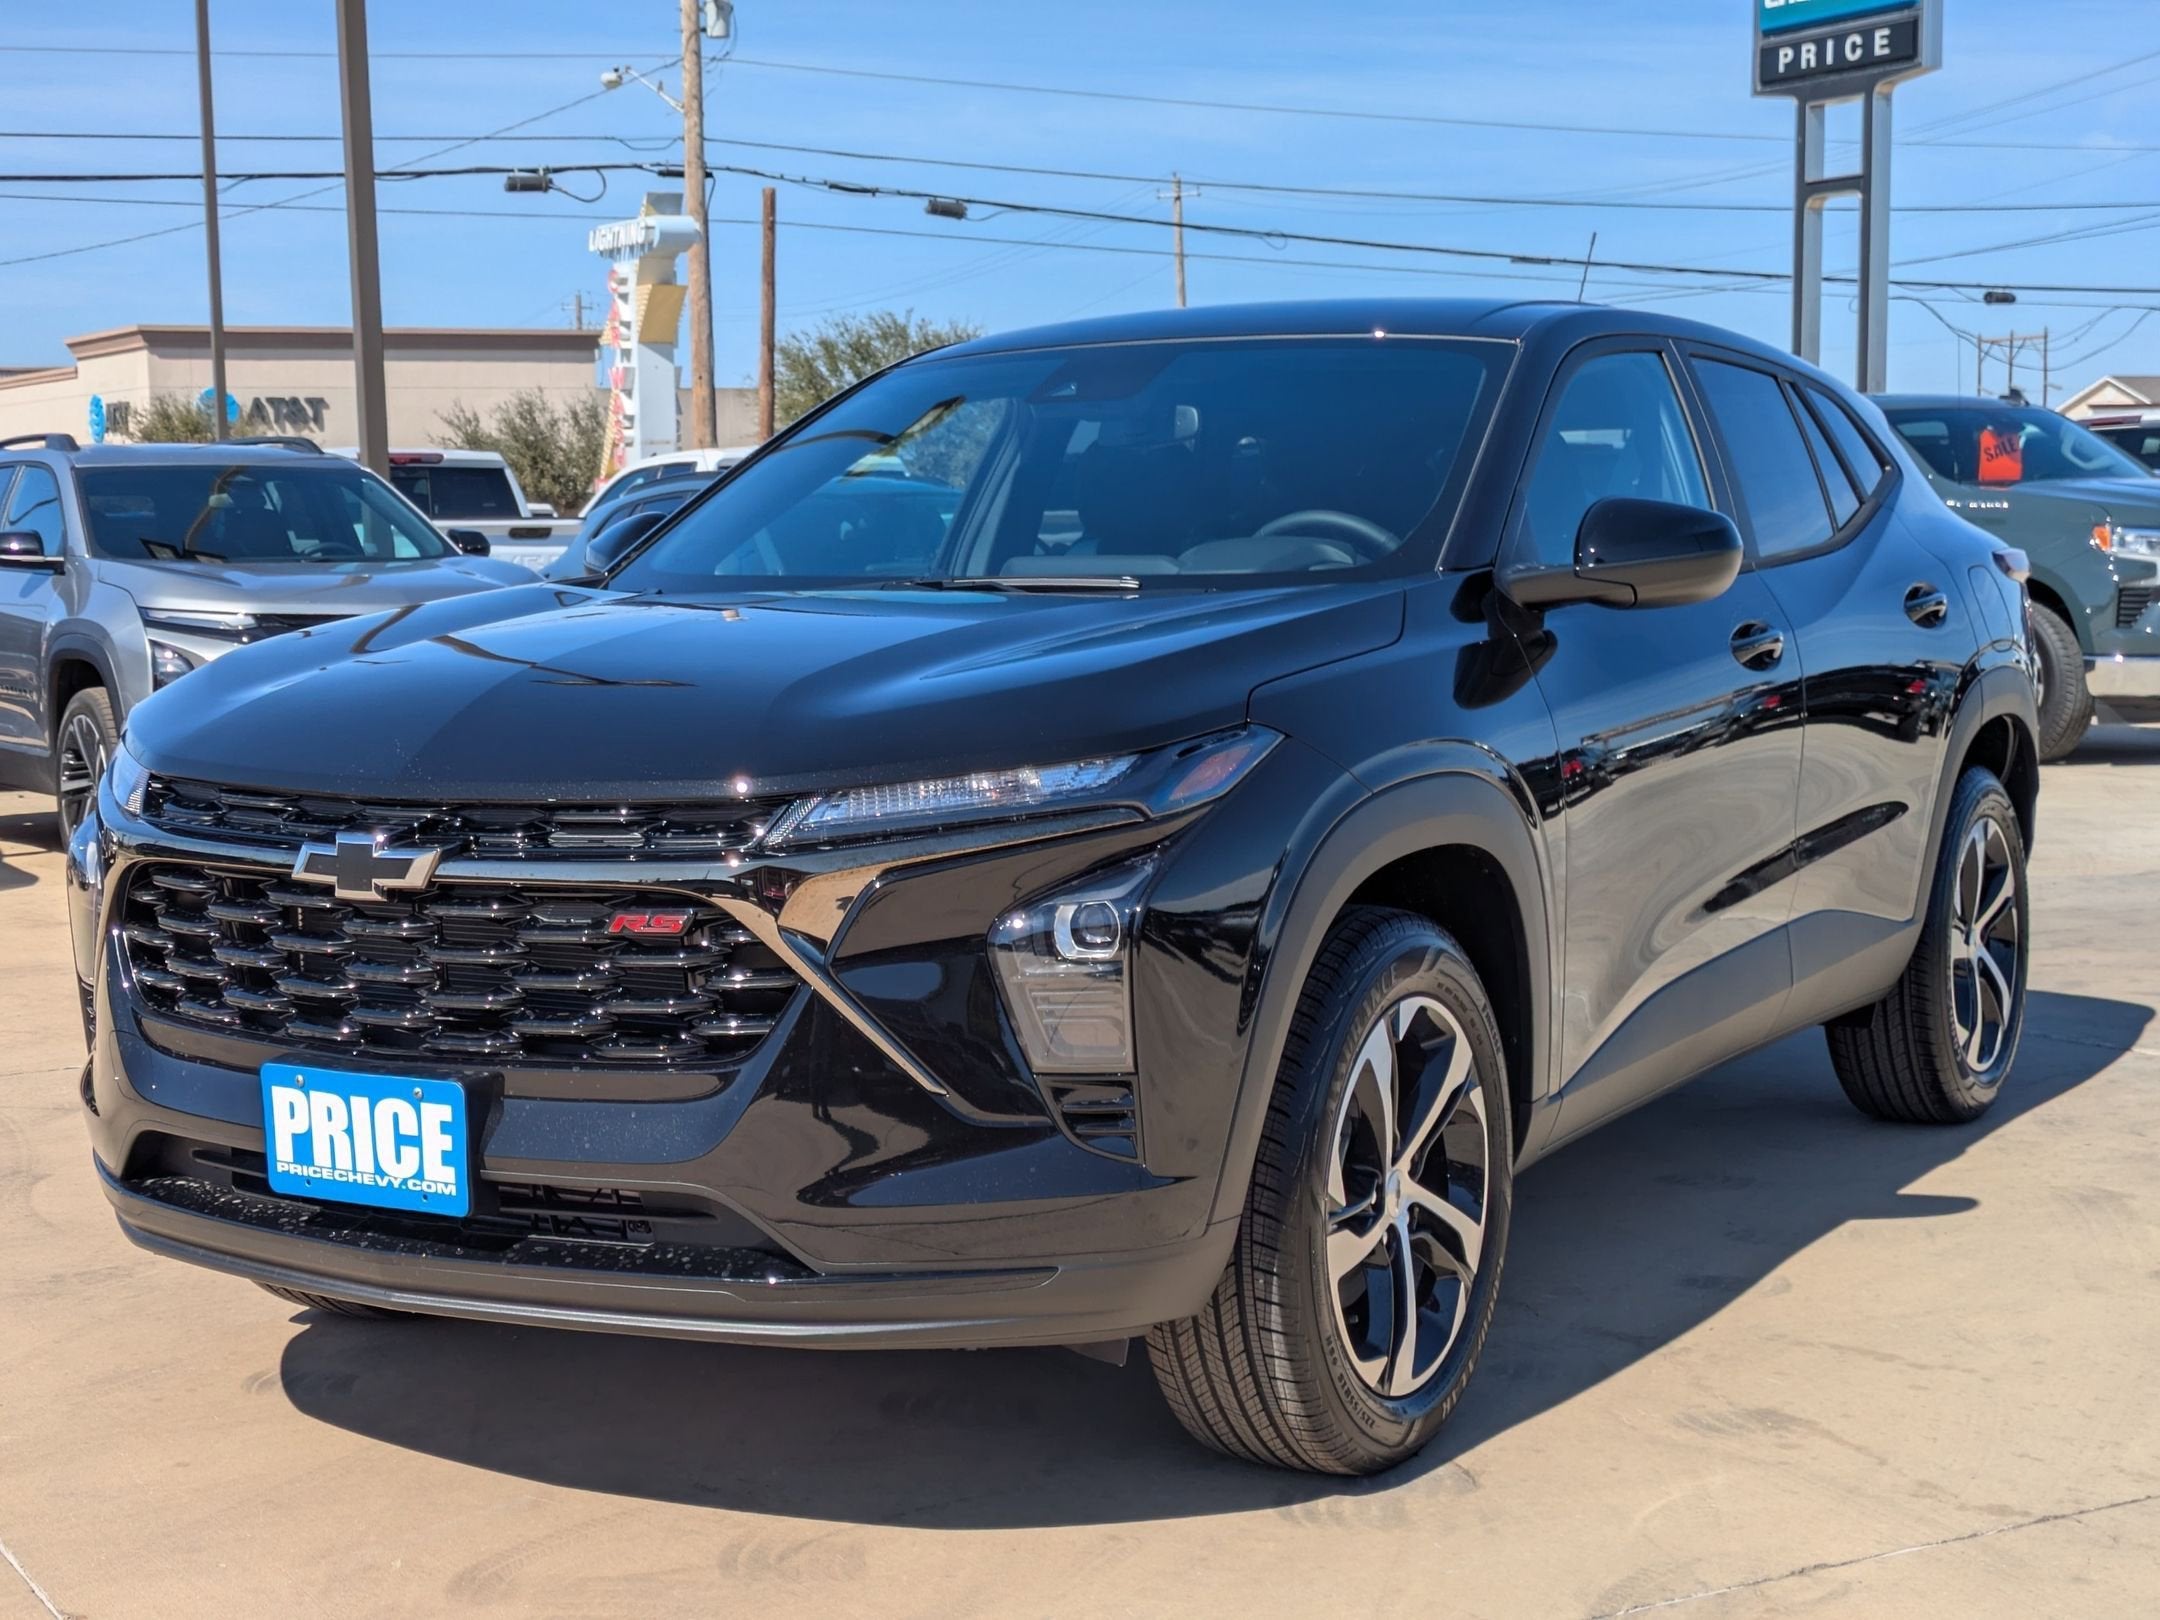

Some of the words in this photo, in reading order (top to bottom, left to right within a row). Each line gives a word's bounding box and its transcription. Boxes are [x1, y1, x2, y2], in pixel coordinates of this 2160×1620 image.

[1778, 28, 1892, 73] PRICE
[588, 221, 645, 252] LIGHTNING
[247, 397, 328, 431] AT&T
[1984, 437, 2018, 462] SALE
[608, 914, 687, 934] RS
[271, 1086, 456, 1183] PRICE
[277, 1162, 457, 1196] PRICECHEVY.COM
